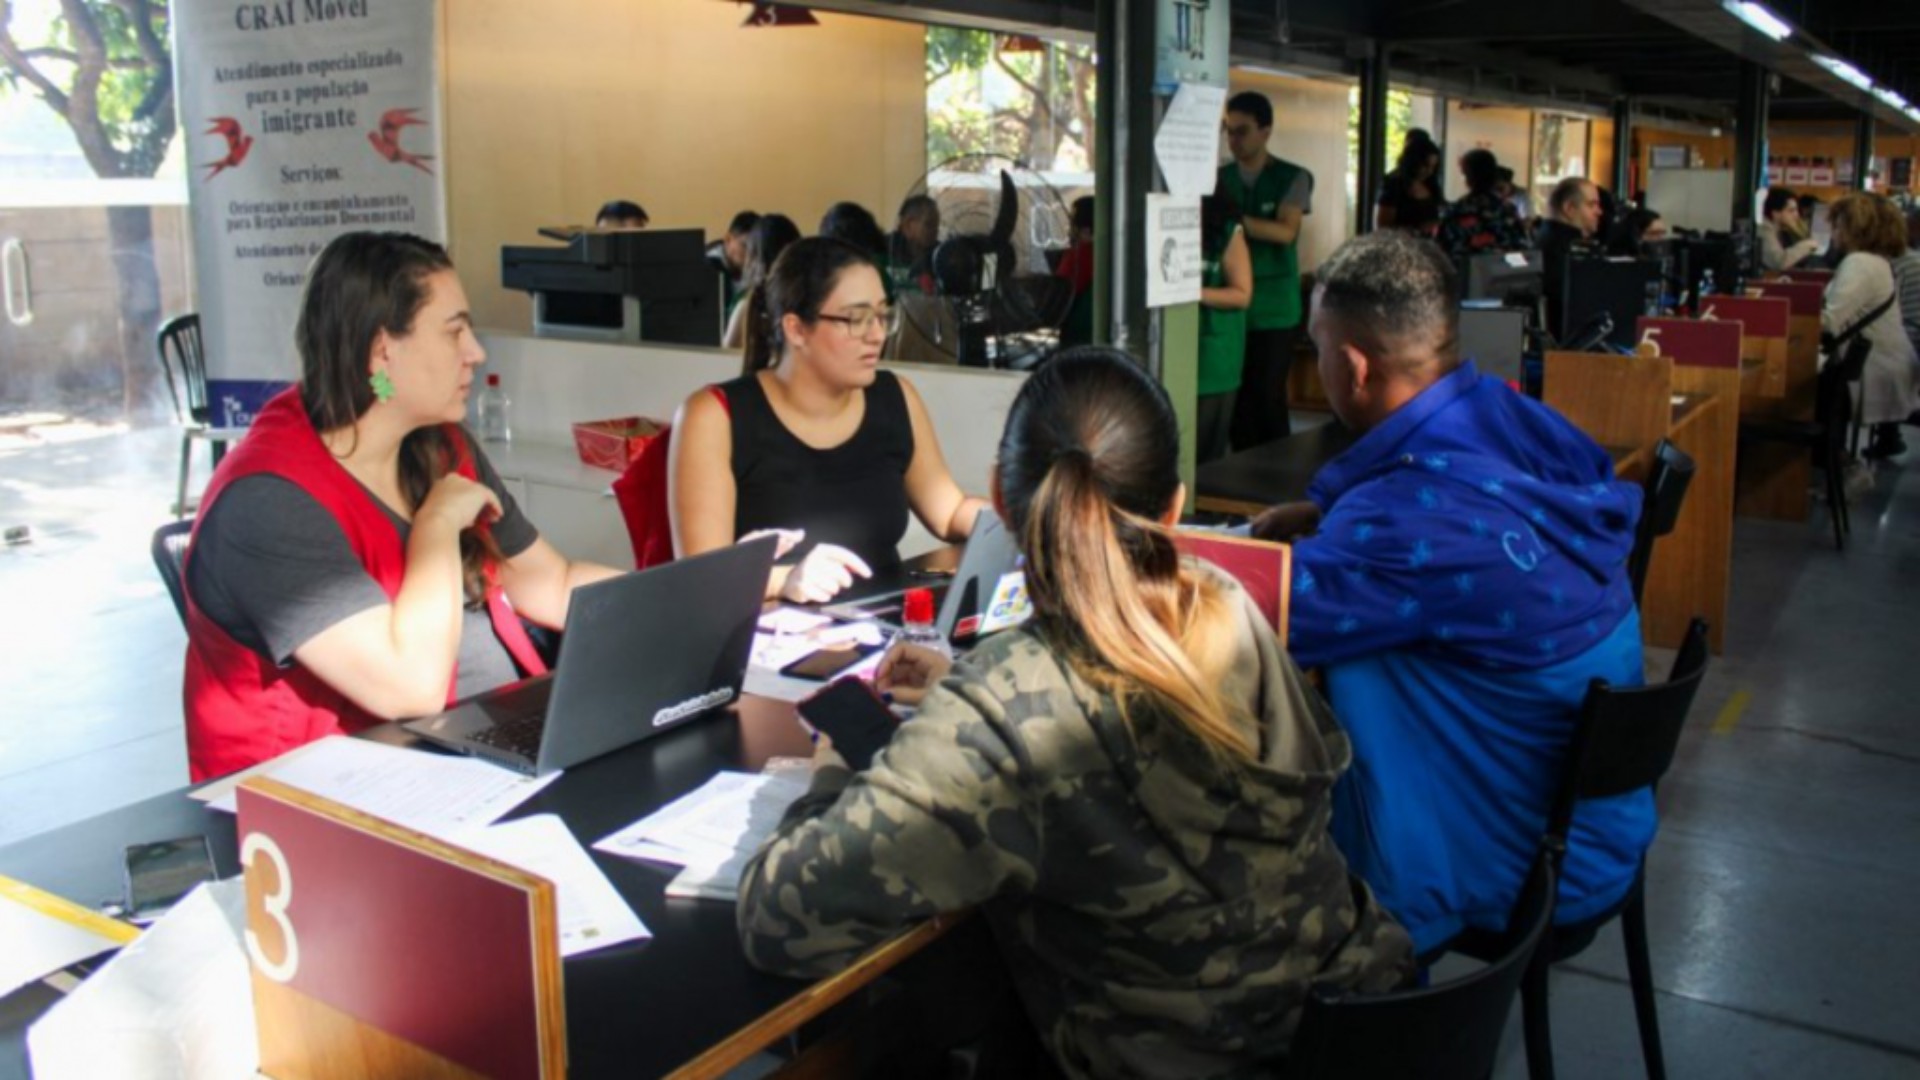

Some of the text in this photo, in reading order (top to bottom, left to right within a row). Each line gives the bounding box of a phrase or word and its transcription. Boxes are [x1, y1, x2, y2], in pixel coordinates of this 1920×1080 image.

[235, 0, 295, 31] CRAI
[214, 49, 403, 83] Atendimento especializado
[245, 80, 369, 108] para a população
[261, 107, 357, 134] imigrante
[1640, 328, 1662, 357] 5
[240, 831, 299, 982] 3
